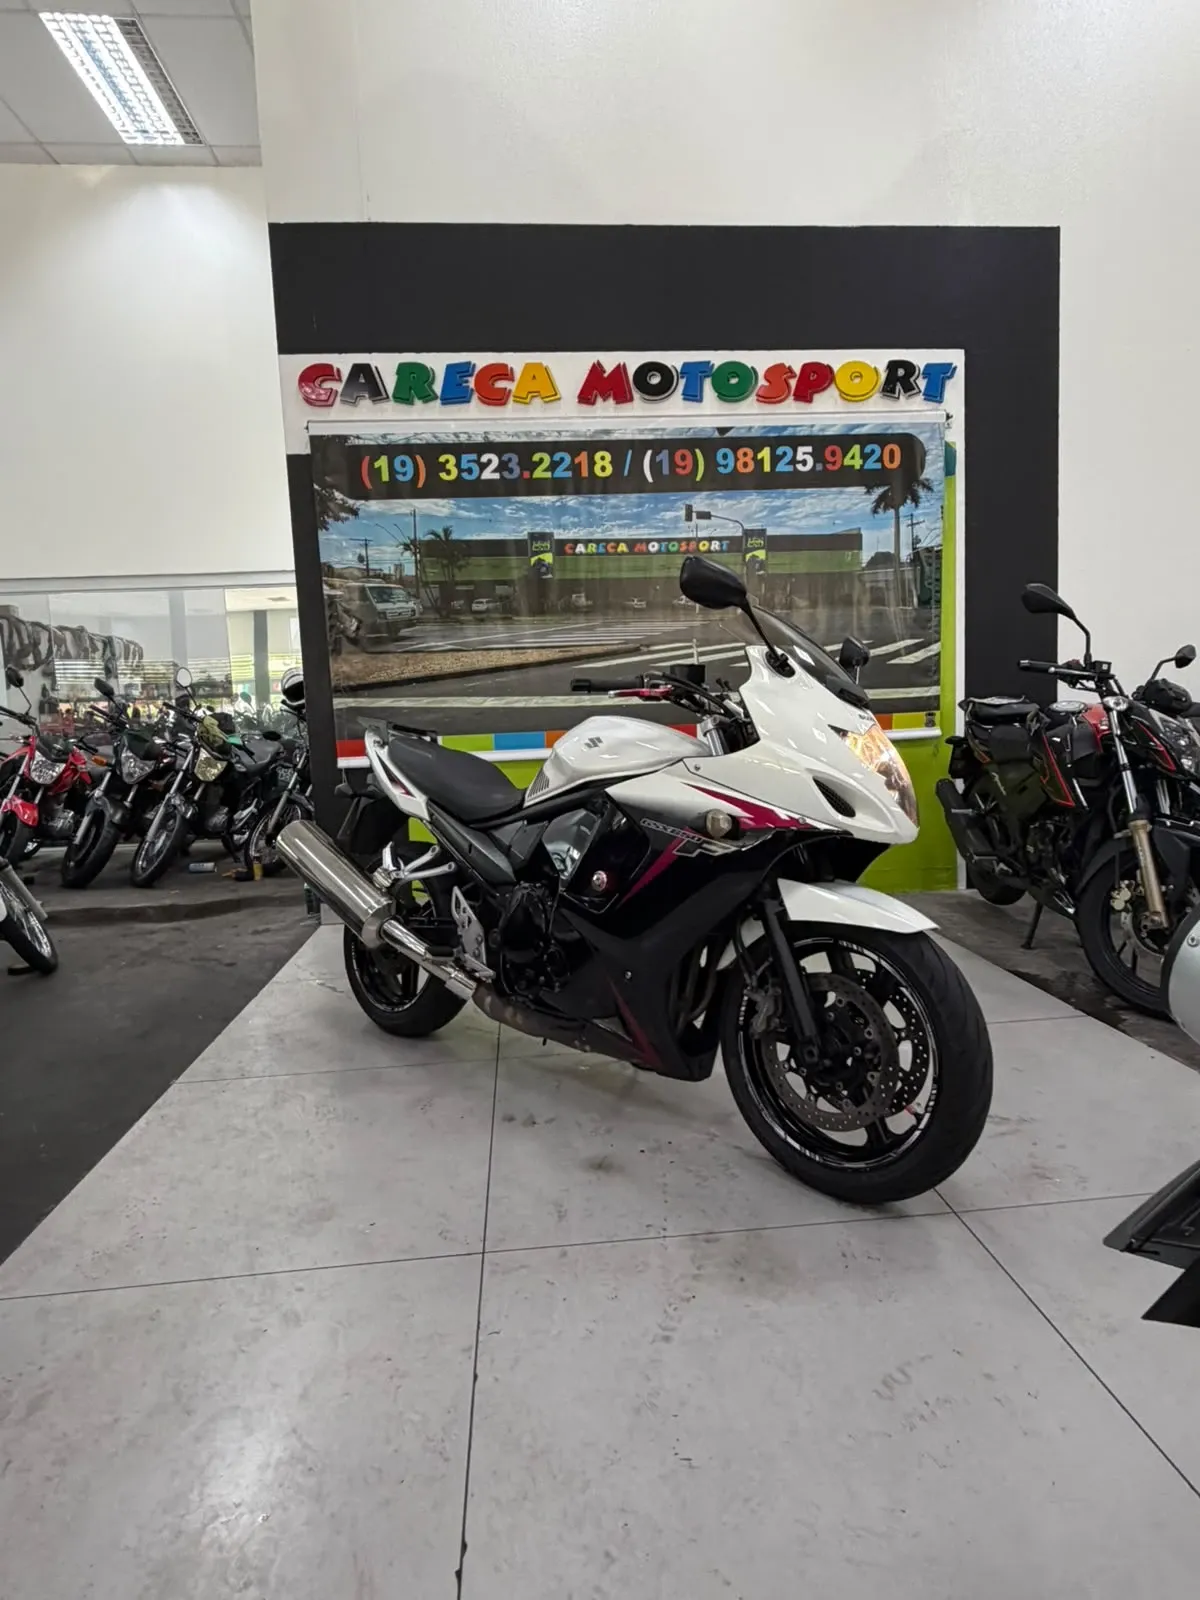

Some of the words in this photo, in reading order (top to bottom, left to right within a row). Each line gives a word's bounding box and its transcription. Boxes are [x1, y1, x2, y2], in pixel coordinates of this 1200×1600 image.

[298, 361, 561, 407] CARECA
[577, 359, 956, 405] MOTOSPORT
[361, 453, 427, 489] (19)
[438, 450, 614, 480] 3523.2218
[643, 448, 704, 483] (19)
[716, 443, 902, 474] 98125.9420
[564, 542, 629, 554] CARECA
[634, 540, 730, 554] MOTOSPORT
